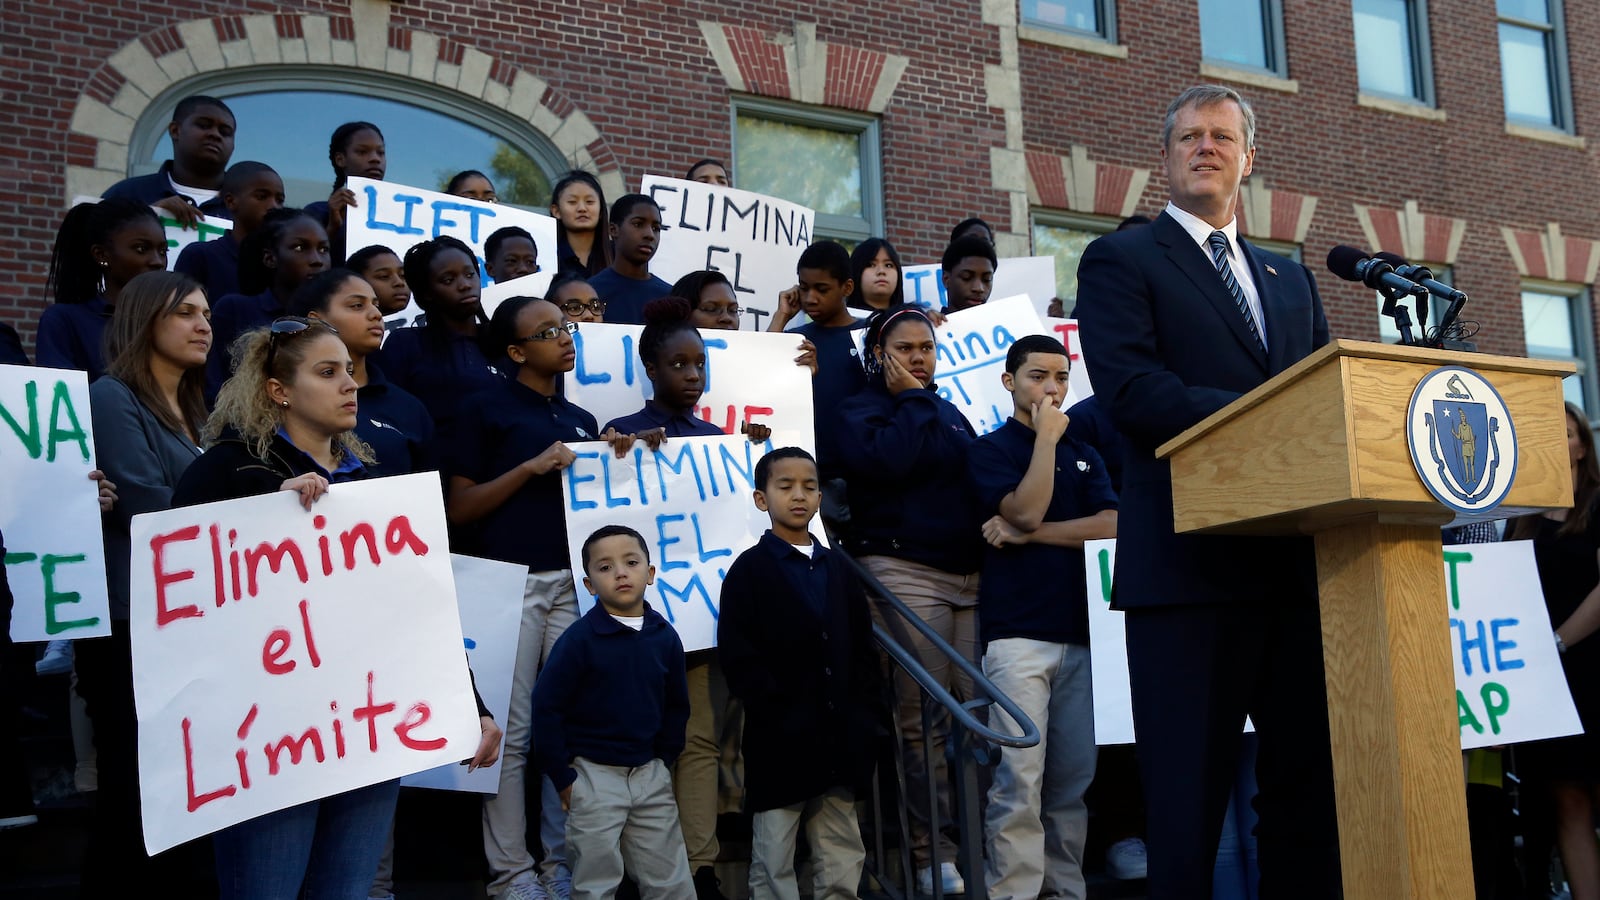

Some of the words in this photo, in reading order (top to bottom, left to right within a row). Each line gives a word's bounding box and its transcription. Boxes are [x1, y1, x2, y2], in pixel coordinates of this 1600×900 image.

[364, 185, 497, 244] LIFT
[650, 184, 809, 247] ELIMINA
[706, 245, 755, 294] EL
[572, 331, 728, 393] LIT
[936, 325, 1016, 366] mina
[150, 514, 429, 628] Elimina
[655, 512, 733, 572] EL
[262, 600, 321, 676] el
[1456, 681, 1510, 736] AP
[181, 671, 448, 812] Límite
